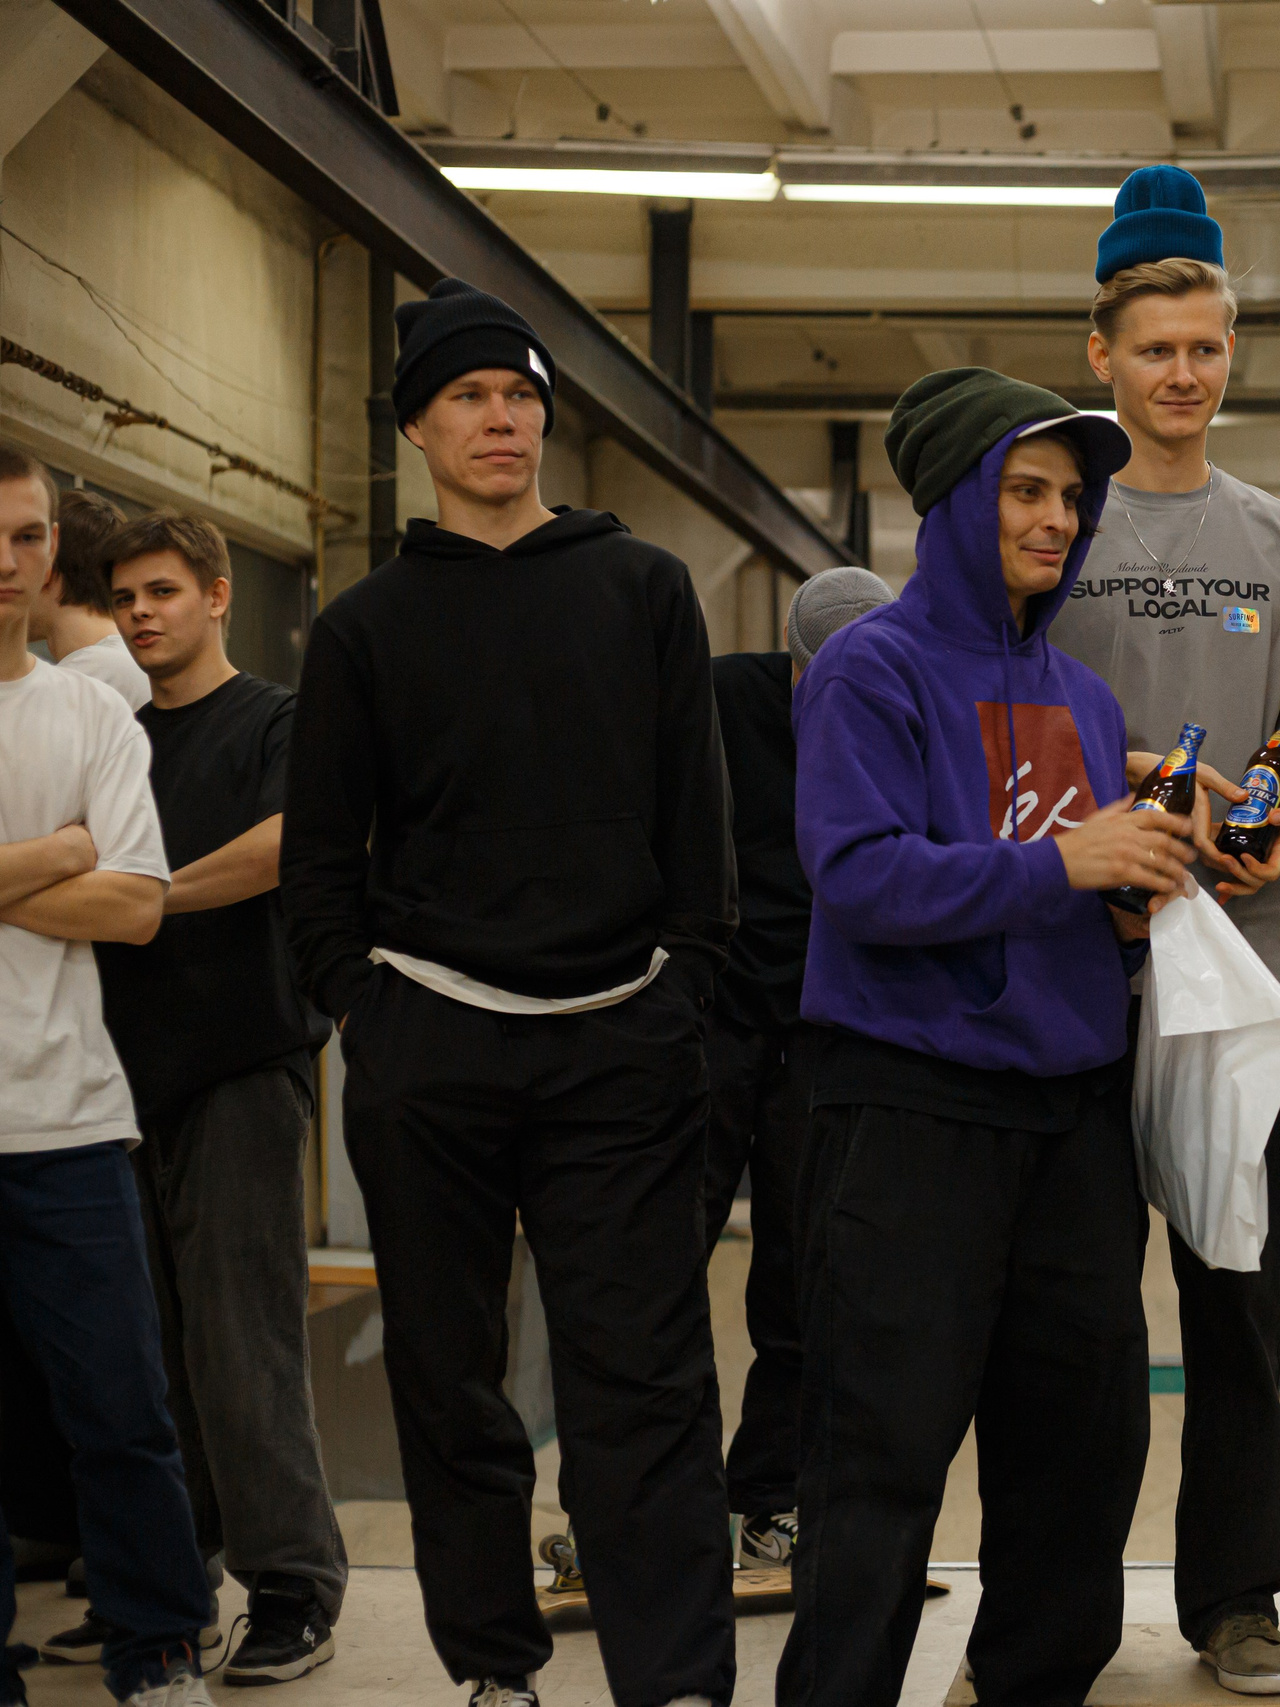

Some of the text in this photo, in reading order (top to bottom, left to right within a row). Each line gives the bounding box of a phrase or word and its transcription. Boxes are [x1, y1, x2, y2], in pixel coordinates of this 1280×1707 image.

[1113, 562, 1156, 573] Molotov
[1196, 578, 1270, 602] YOUR
[1128, 599, 1218, 619] LOCAL
[1228, 613, 1255, 622] SURFING
[1247, 788, 1276, 804] ЛТИКА
